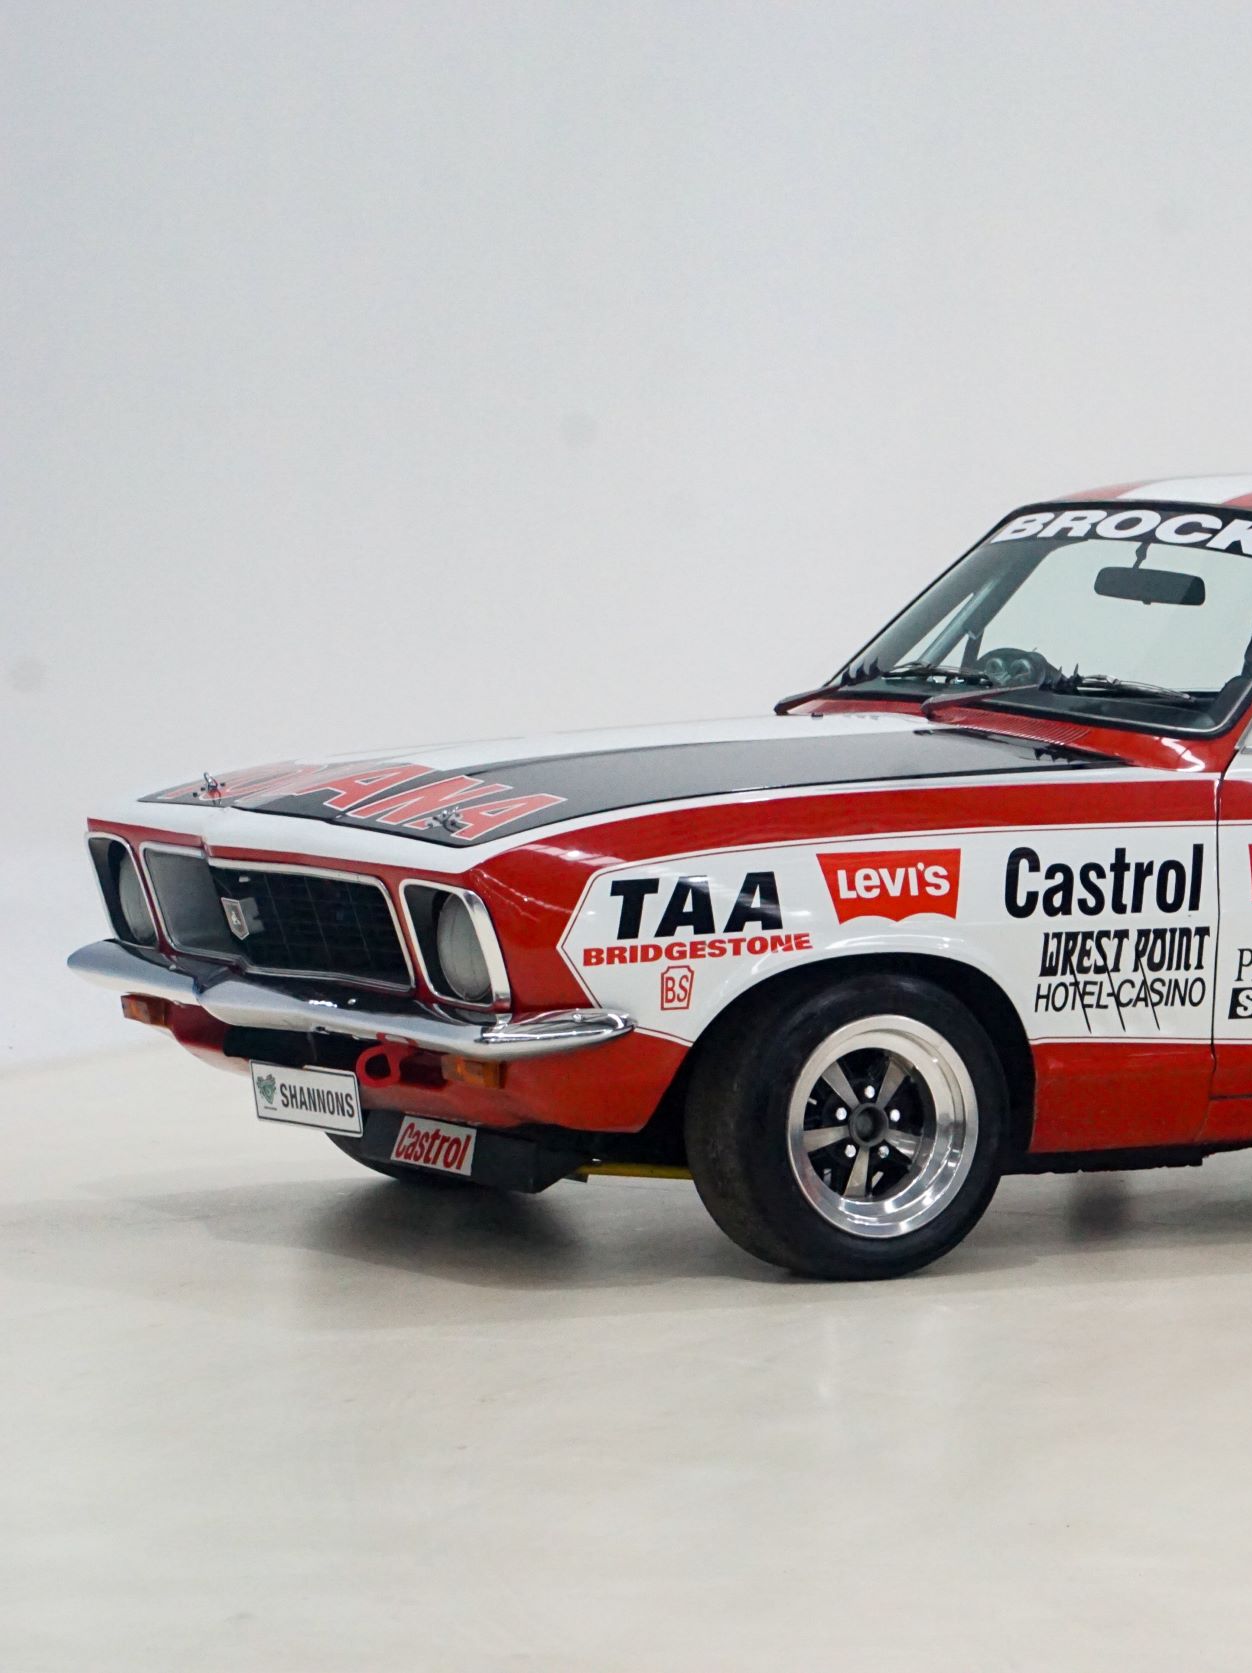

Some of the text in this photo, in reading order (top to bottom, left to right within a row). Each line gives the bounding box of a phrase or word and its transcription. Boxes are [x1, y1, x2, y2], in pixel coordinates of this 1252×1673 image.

[155, 761, 568, 841] OANA
[1004, 843, 1204, 918] Castrol
[610, 871, 784, 940] TAA
[583, 933, 813, 966] BRIDGESTONE
[1039, 926, 1210, 977] WREST POINT
[664, 977, 690, 1003] BS
[280, 1083, 355, 1118] SHANNONS
[395, 1122, 472, 1170] Castrol
